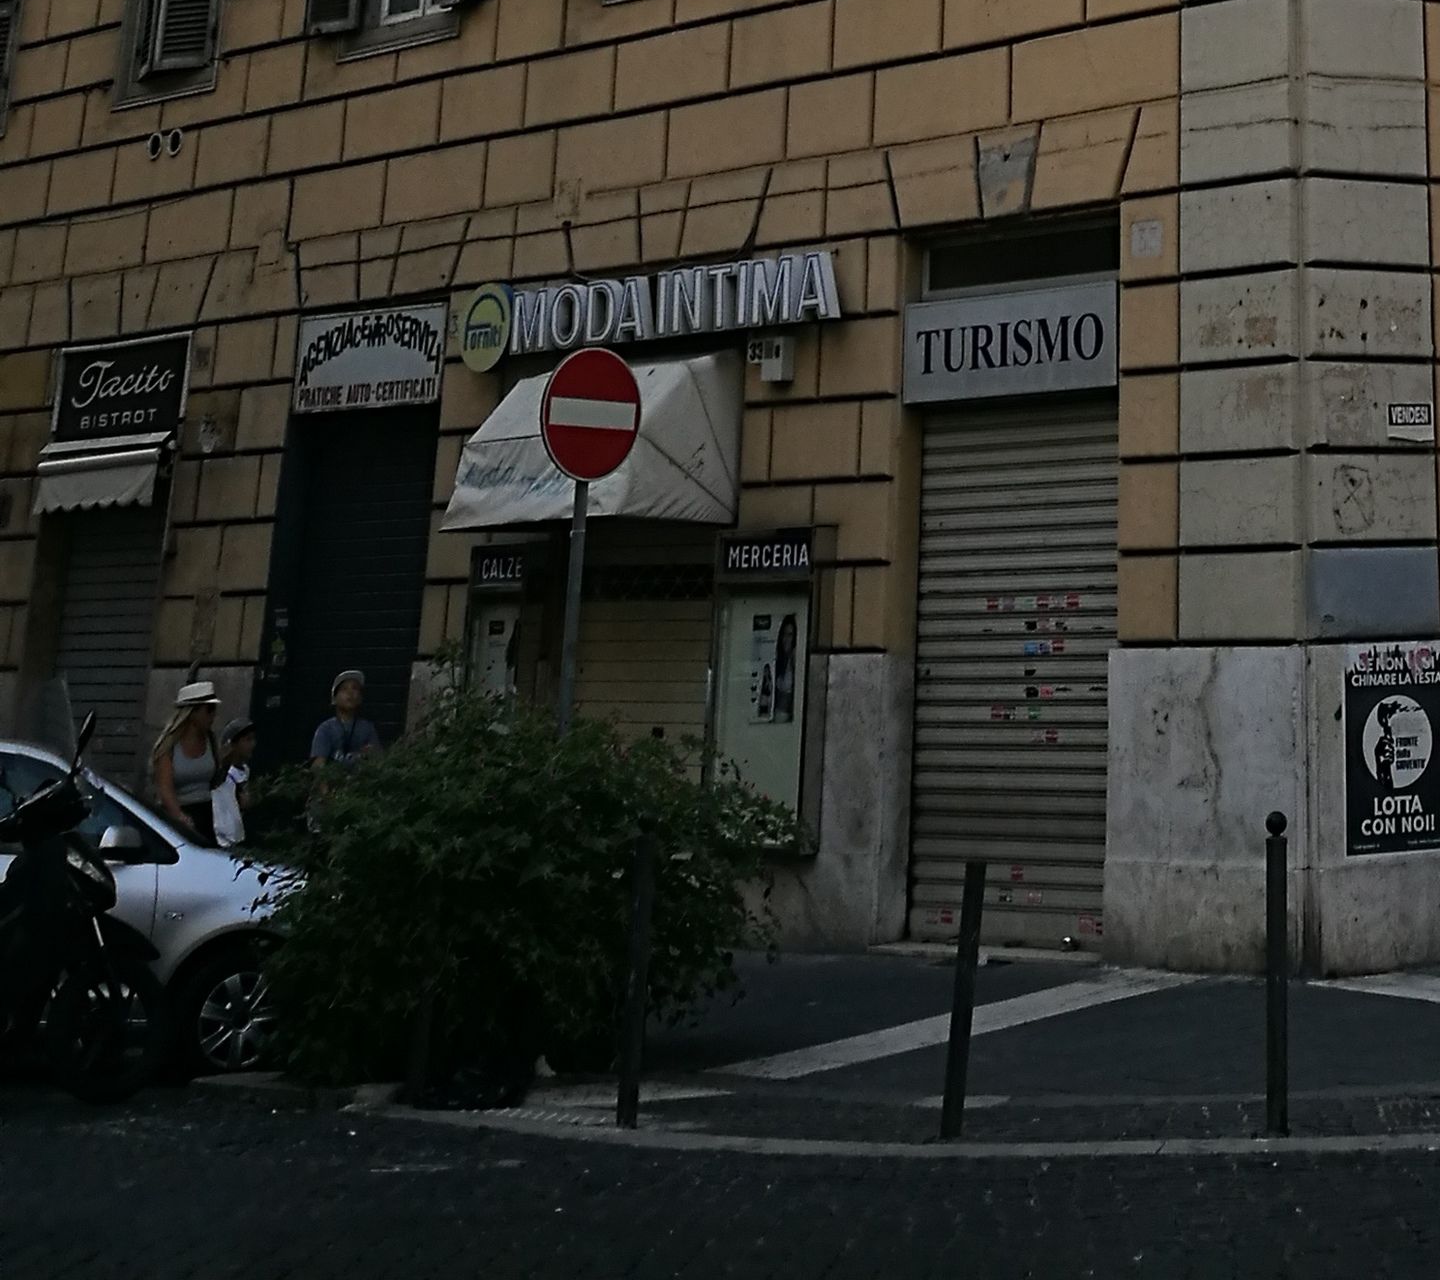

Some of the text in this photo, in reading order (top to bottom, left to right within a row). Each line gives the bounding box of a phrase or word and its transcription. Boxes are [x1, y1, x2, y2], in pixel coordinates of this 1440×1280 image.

[510, 251, 841, 356] MODA INTIMA
[300, 318, 354, 386] AGENZIA
[393, 313, 441, 375] SERVIZI
[916, 312, 1104, 374] TURISMO
[71, 360, 176, 408] Tacito
[299, 385, 342, 408] PRATICHE
[80, 408, 158, 429] BISTROT
[1391, 406, 1429, 424] VENDESI
[481, 556, 523, 580] CALZE
[727, 543, 809, 569] MERCERIA
[1351, 672, 1398, 688] CHINARE
[1399, 671, 1412, 685] LA
[1374, 794, 1424, 817] LOTTA
[1361, 813, 1436, 837] CON NOI!
